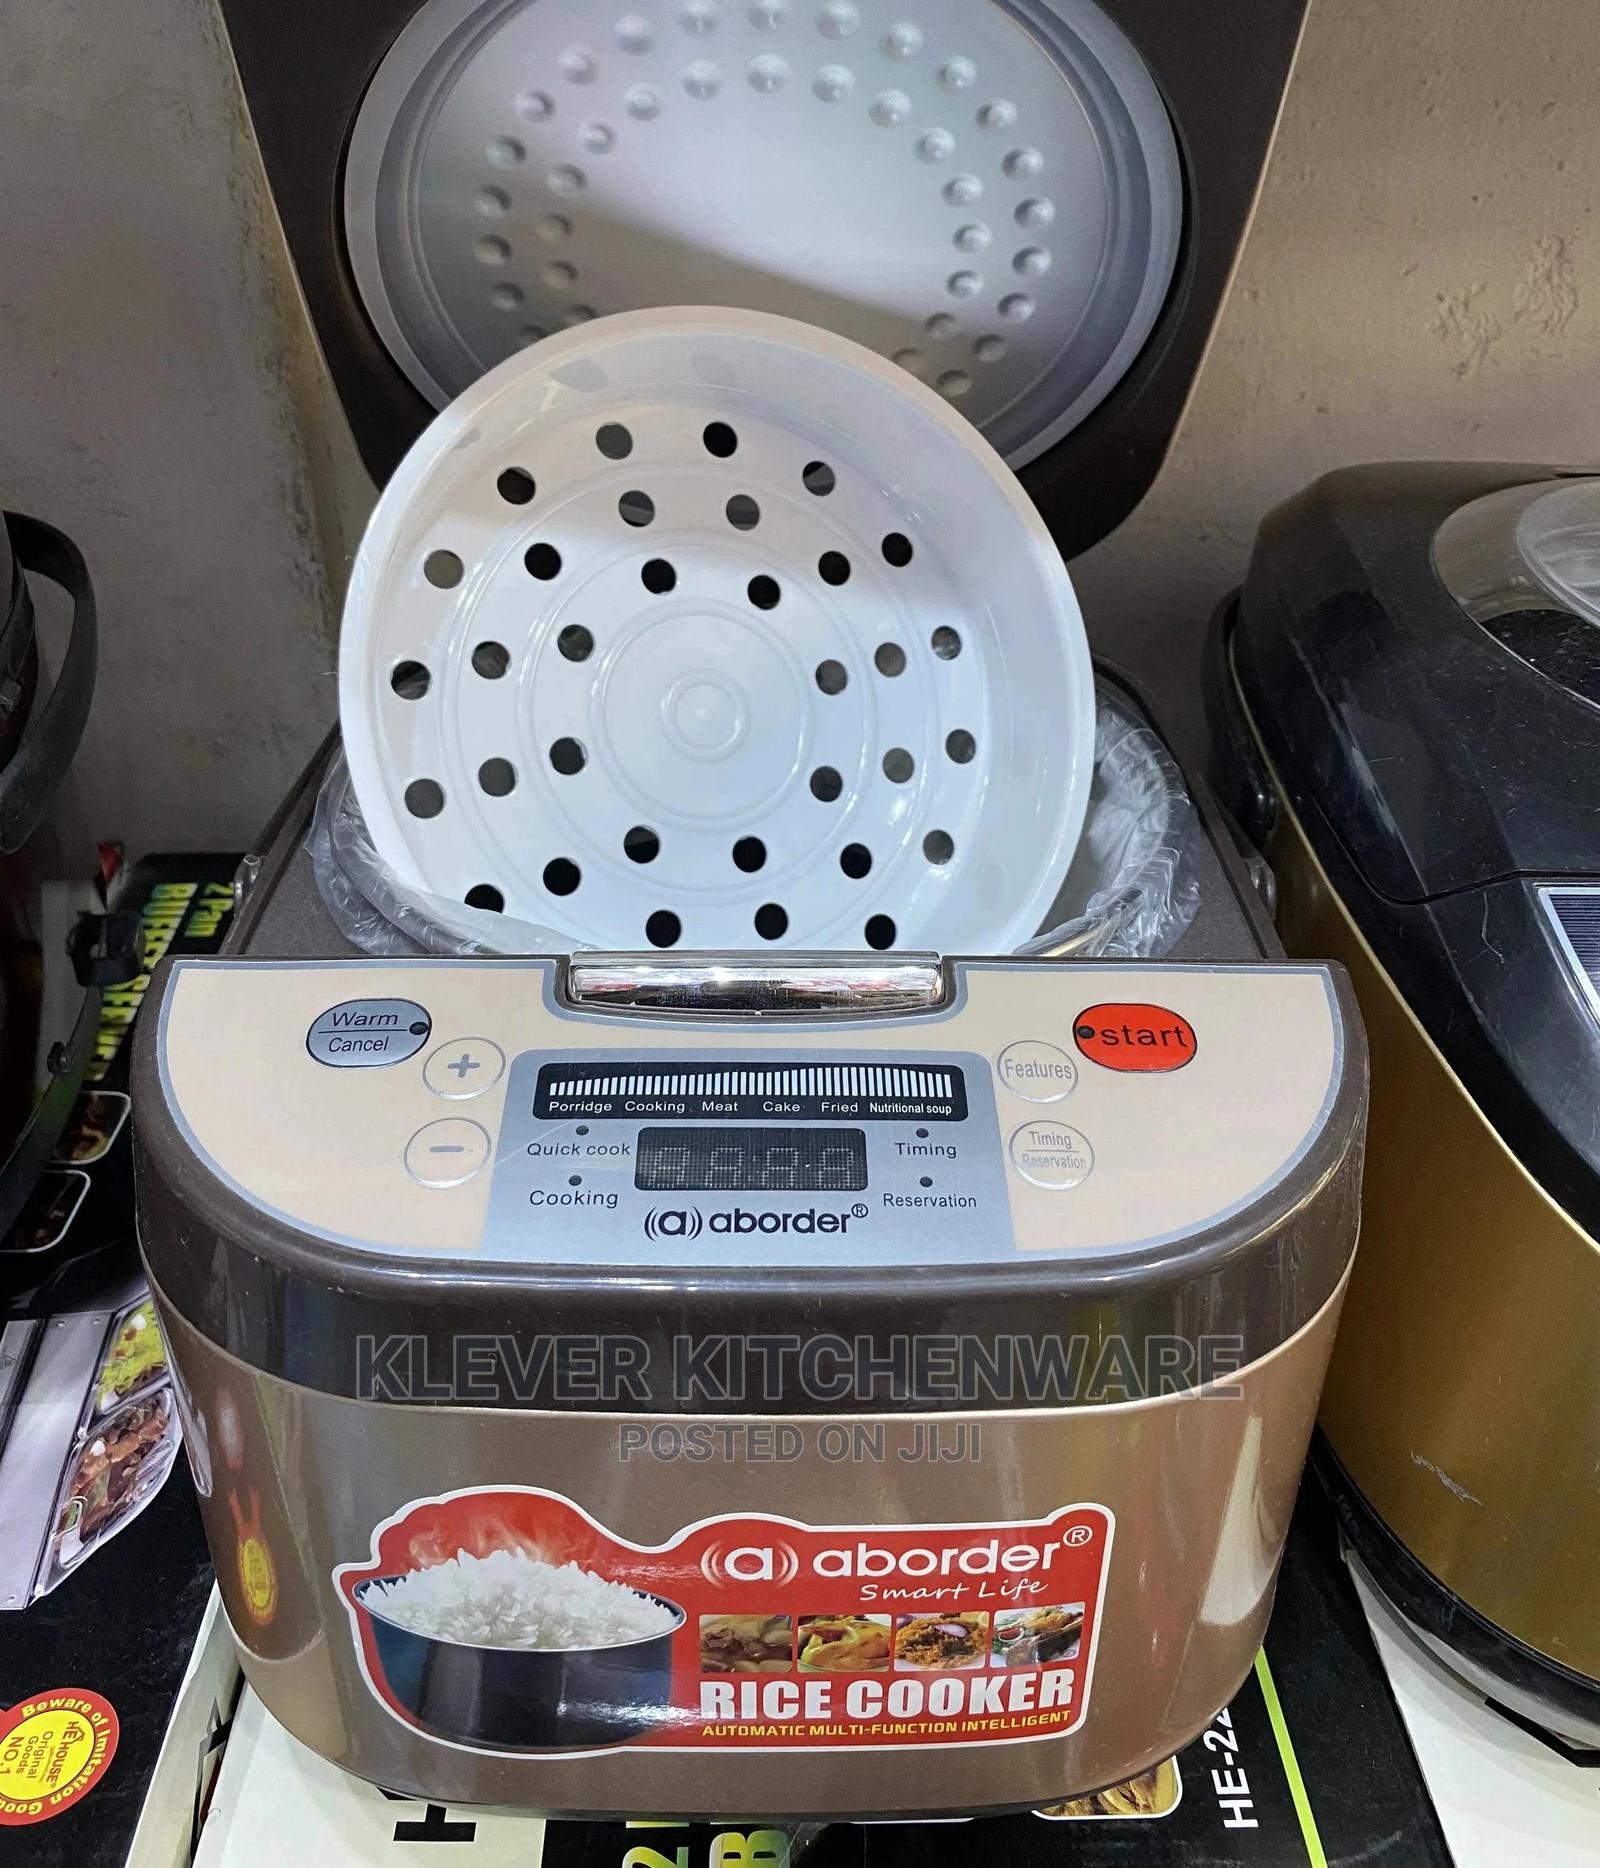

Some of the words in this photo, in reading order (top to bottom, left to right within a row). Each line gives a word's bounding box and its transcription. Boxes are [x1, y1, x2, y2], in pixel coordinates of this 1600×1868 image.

[332, 1012, 398, 1026] Warm
[328, 1036, 389, 1052] Cancel
[1100, 1024, 1188, 1048] start
[1004, 1058, 1072, 1080] Features
[549, 1101, 613, 1114] Porridge
[625, 1101, 685, 1114] Cooking
[702, 1101, 738, 1112] Meat
[762, 1101, 800, 1112] Cake
[821, 1101, 858, 1113] Fried
[870, 1102, 925, 1115] Nutritional
[926, 1104, 952, 1116] soup
[527, 1143, 581, 1156] Quick
[586, 1143, 631, 1155] cook
[894, 1142, 957, 1158] Timing
[1028, 1131, 1072, 1150] Timing
[1022, 1153, 1087, 1170] Reservation
[529, 1190, 618, 1209] Cooking
[883, 1193, 977, 1208] Reservation
[859, 1583, 970, 1602] Smart
[977, 1578, 1049, 1598] Life
[700, 1680, 832, 1720] RICE
[846, 1668, 1075, 1720] COOKER
[21, 1698, 92, 1718] Beware
[91, 1712, 109, 1727] of
[702, 1724, 805, 1736] AUTOMATIC
[809, 1721, 958, 1736] MULTI-FUNCTION
[962, 1710, 1072, 1731] INTELLIGENT
[16, 1736, 39, 1774] Goods
[26, 1731, 54, 1779] Original
[49, 1729, 112, 1805] Imitation
